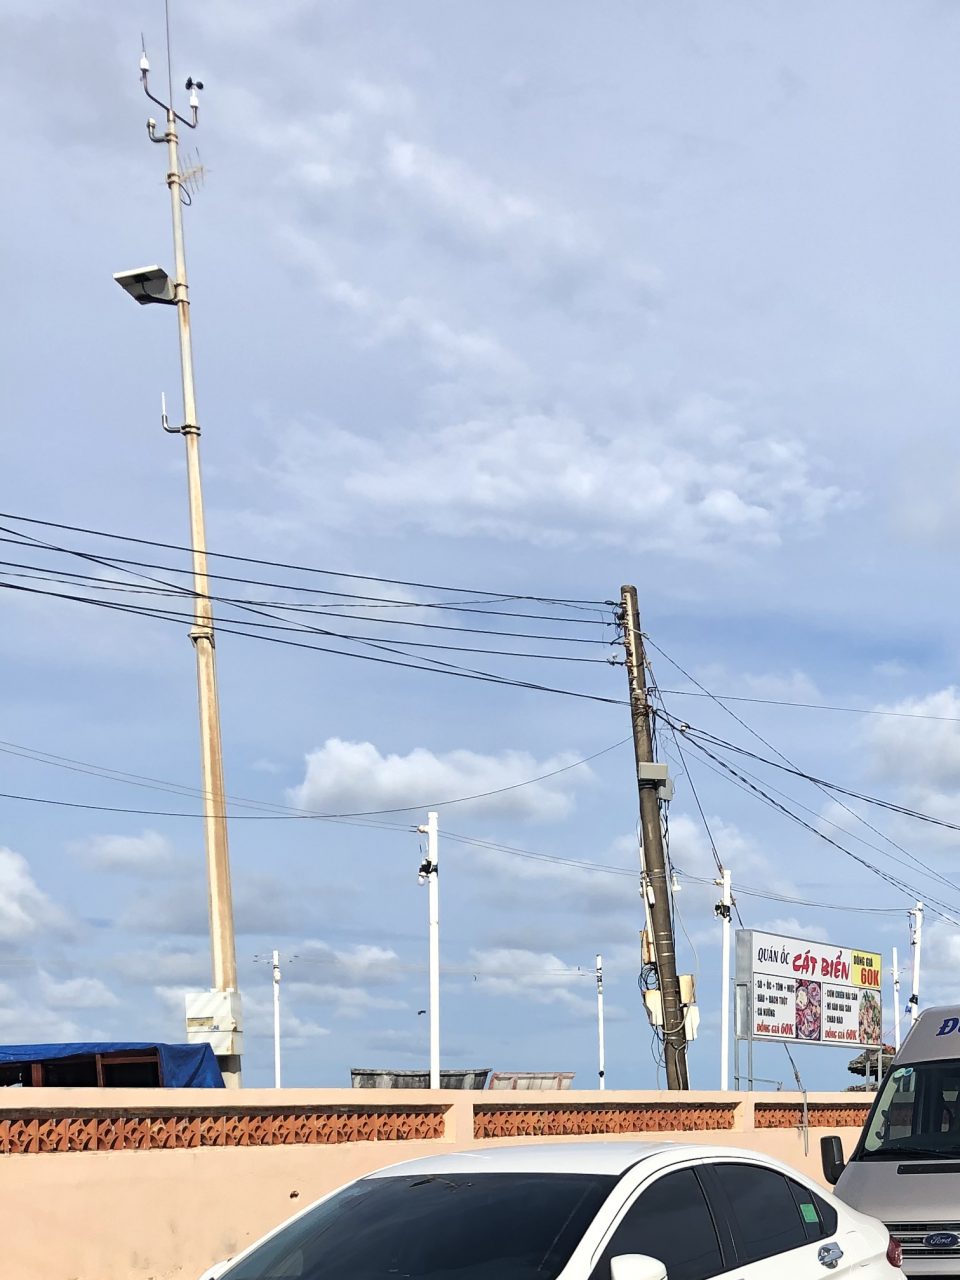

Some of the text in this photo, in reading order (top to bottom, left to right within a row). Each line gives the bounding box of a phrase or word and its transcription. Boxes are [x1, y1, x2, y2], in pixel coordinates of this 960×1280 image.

[757, 945, 790, 965] QUÁN ỐC
[792, 949, 850, 981] CÁT BIỂN
[860, 967, 880, 987] 60K
[780, 1023, 794, 1036] 60K
[845, 1029, 858, 1041] 60K
[930, 1236, 952, 1245] Ford
